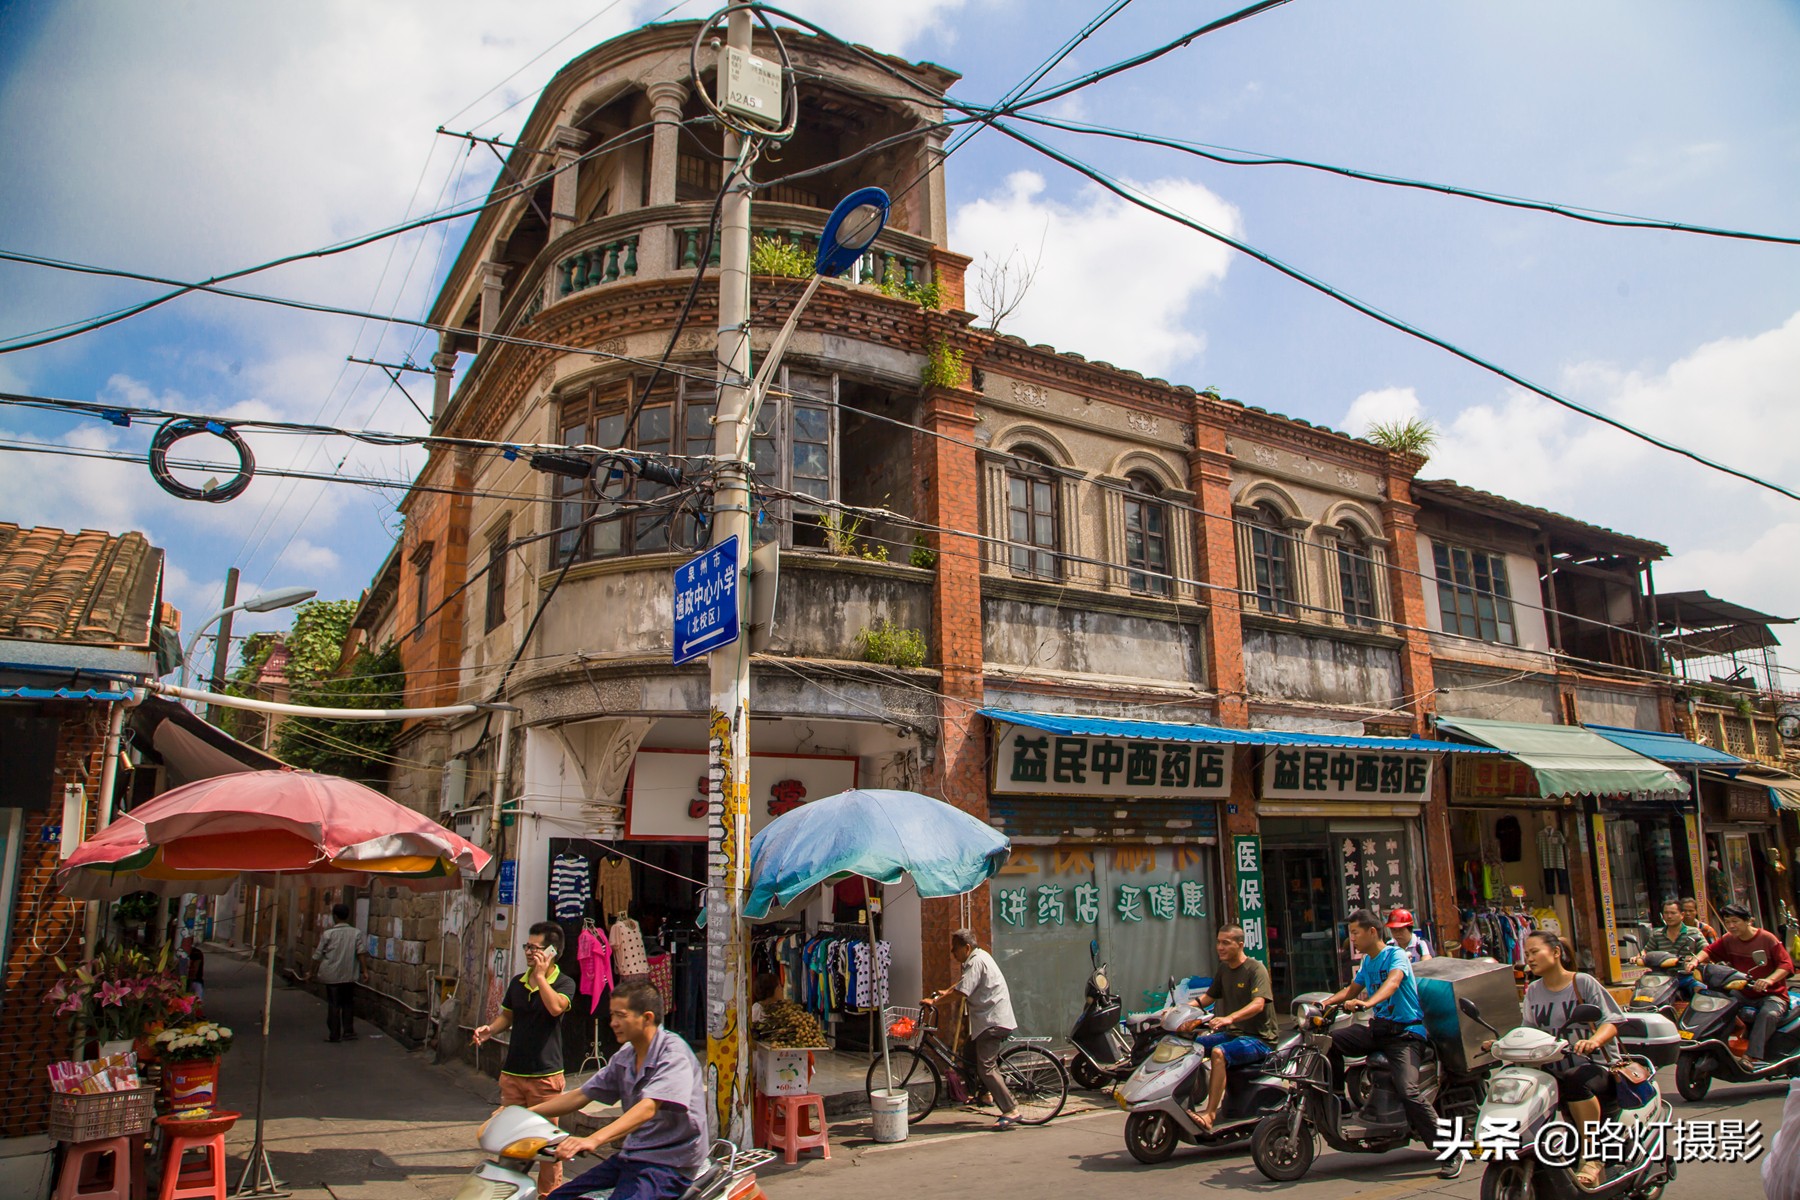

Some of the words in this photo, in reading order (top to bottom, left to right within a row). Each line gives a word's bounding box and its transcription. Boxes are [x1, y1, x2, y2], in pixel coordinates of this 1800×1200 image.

[676, 564, 734, 620] 通政中心小学
[687, 551, 720, 583] 泉州市
[1010, 735, 1224, 788] 益民中西药店
[1273, 750, 1427, 794] 益民中西药店
[999, 882, 1100, 928] 进药店
[1116, 879, 1207, 923] 买健康
[1237, 841, 1264, 962] 医保刷
